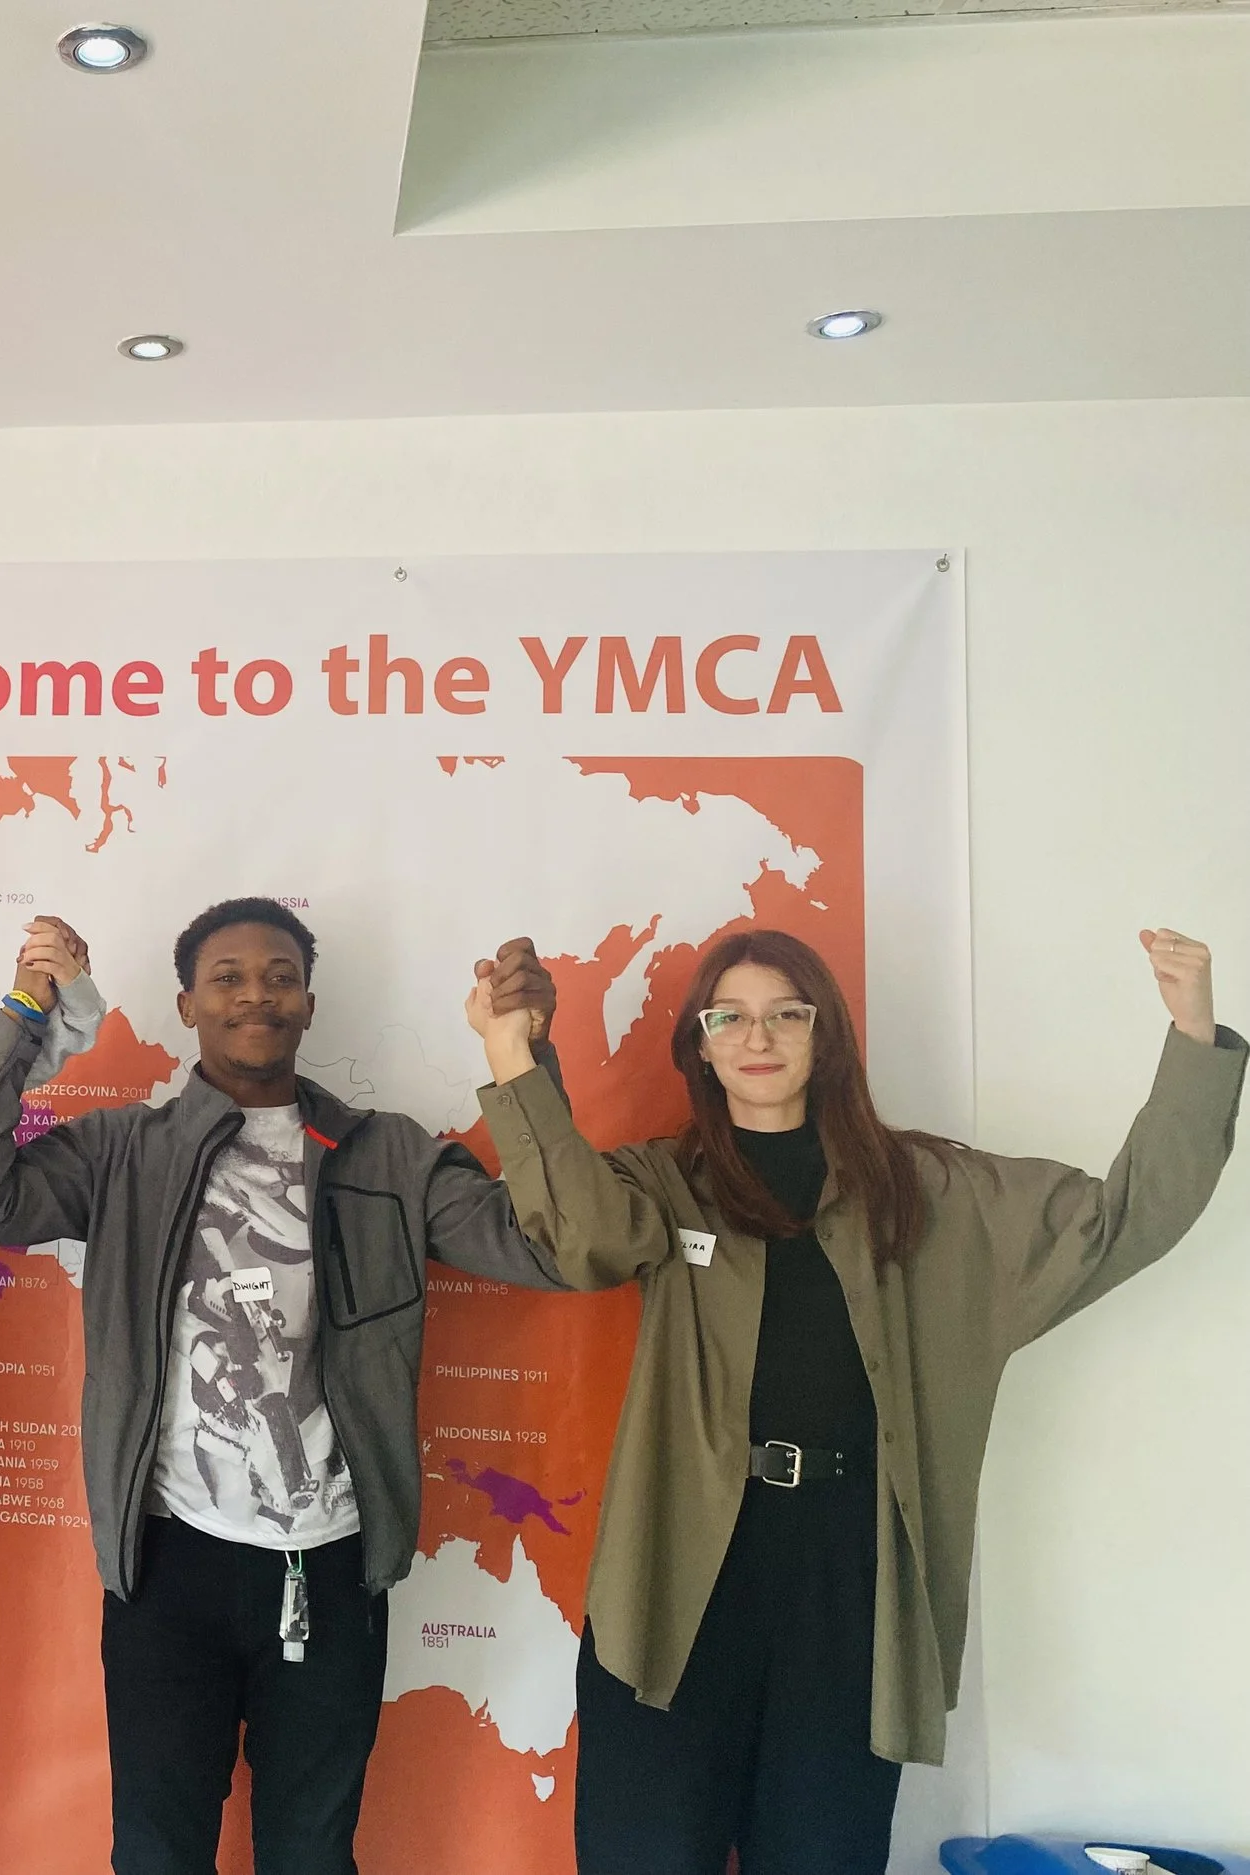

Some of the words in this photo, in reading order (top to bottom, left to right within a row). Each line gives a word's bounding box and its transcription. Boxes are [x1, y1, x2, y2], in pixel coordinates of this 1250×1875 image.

[191, 647, 293, 717] to
[321, 634, 490, 715] the
[518, 634, 844, 715] YMCA
[6, 893, 34, 904] 1920
[122, 1087, 148, 1098] 2011
[28, 1099, 52, 1110] 1991
[19, 1275, 48, 1289] 1876
[232, 1281, 270, 1290] DWIGHT
[427, 1280, 473, 1293] AIWAN
[477, 1282, 509, 1295] 1945
[30, 1364, 55, 1377] 1951
[436, 1365, 519, 1381] PHILIPPINES
[523, 1370, 548, 1383] 1911
[13, 1422, 57, 1435] SUDAN
[61, 1424, 82, 1437] 201
[435, 1426, 512, 1442] INDONESIA
[516, 1431, 547, 1444] 1928
[10, 1439, 36, 1451] 1910
[30, 1458, 59, 1471] 1959
[15, 1477, 44, 1490] 1958
[36, 1496, 65, 1509] 1968
[60, 1514, 88, 1528] 1924
[421, 1623, 497, 1639] AUSTRALIA
[421, 1635, 449, 1649] 1851
